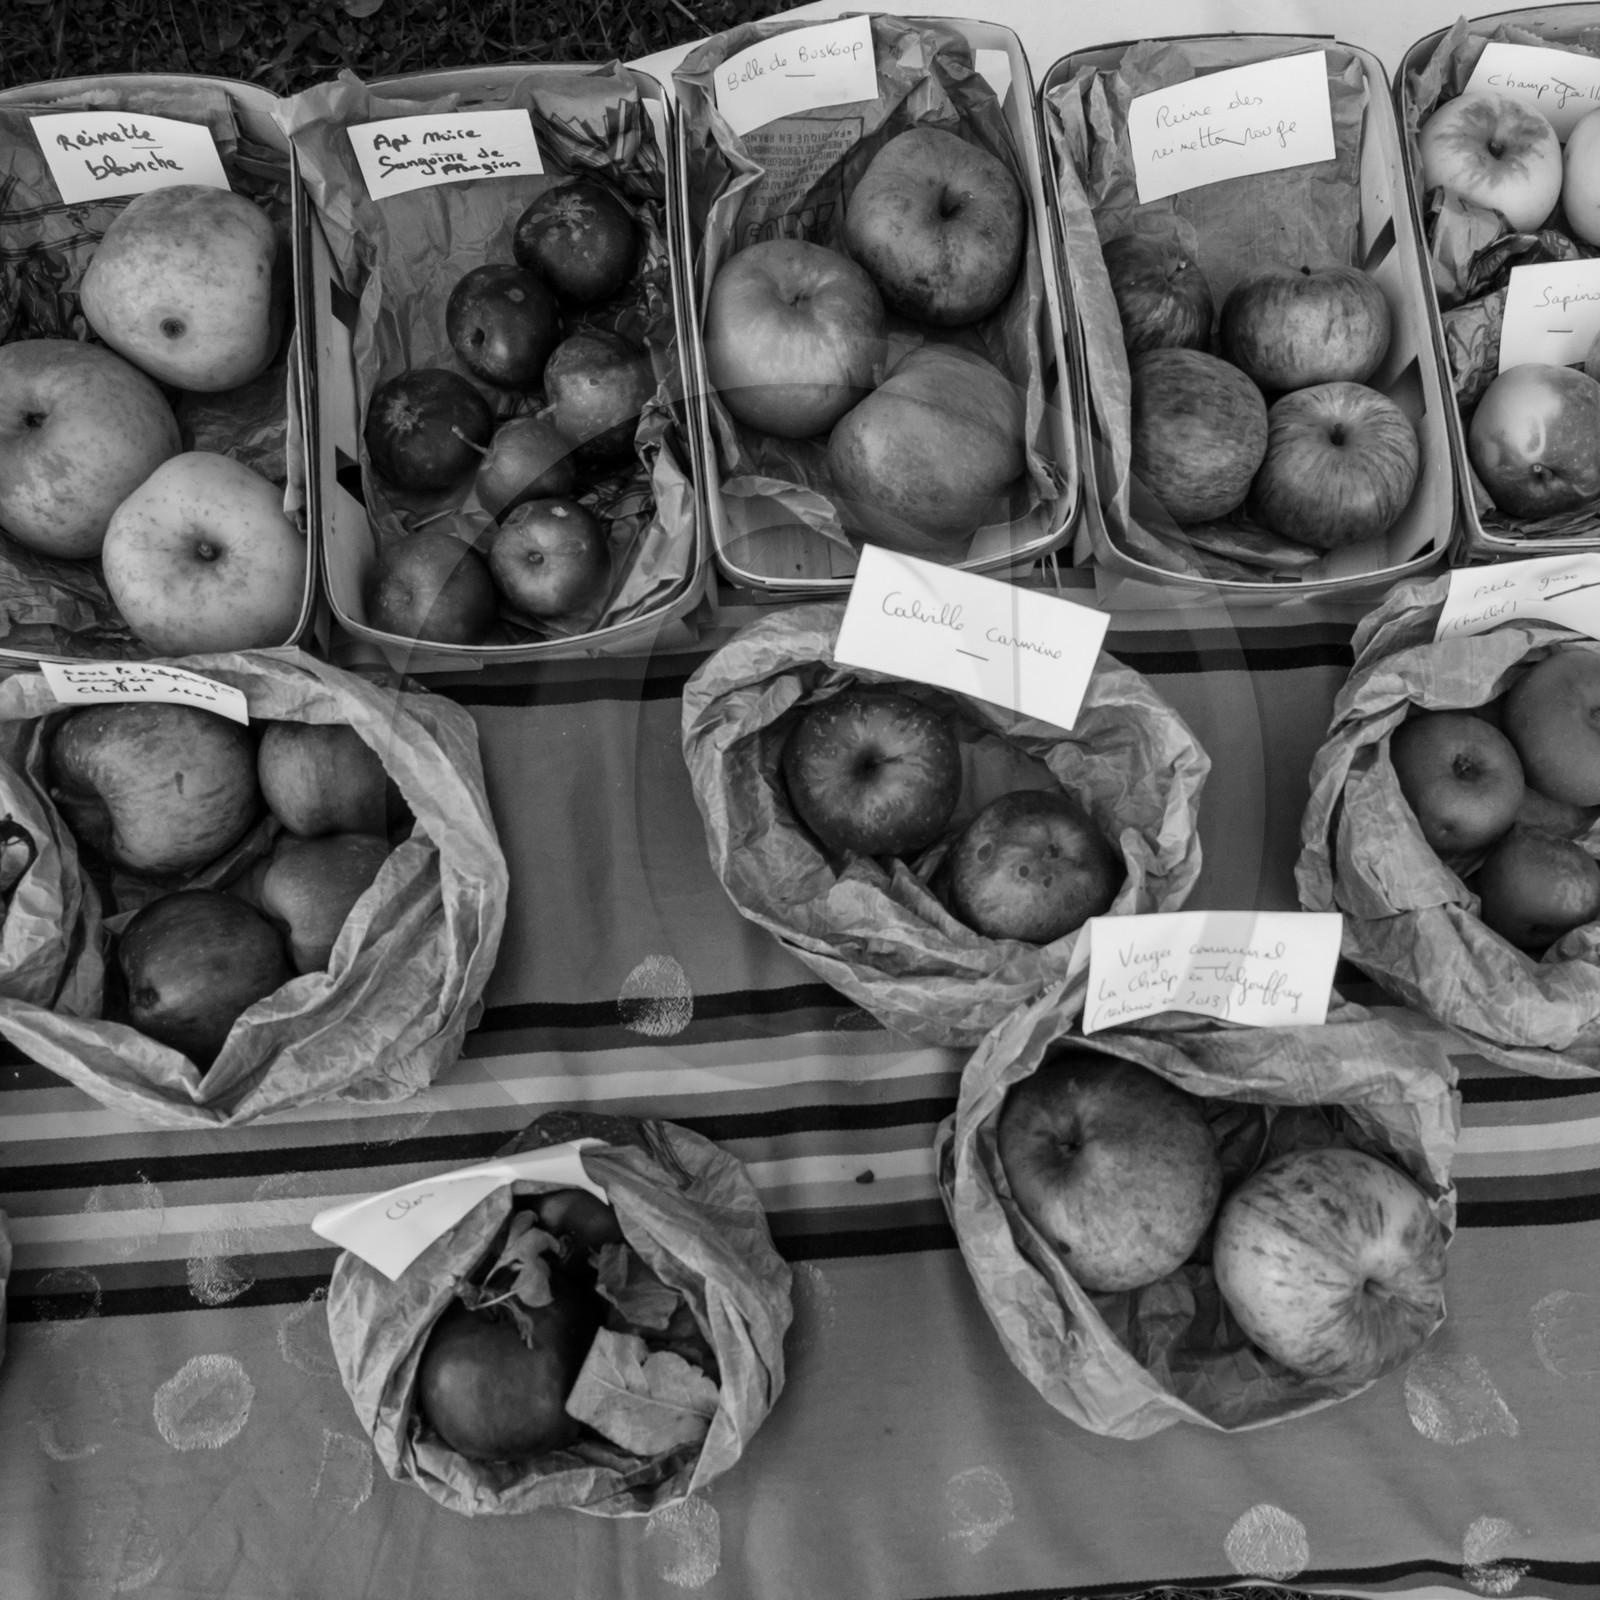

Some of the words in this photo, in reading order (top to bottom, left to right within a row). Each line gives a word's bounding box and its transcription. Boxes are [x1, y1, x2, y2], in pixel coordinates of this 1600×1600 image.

[727, 58, 765, 92] Belle
[769, 53, 787, 71] de
[1487, 72, 1550, 100] Champ
[1156, 103, 1212, 129] Reine
[1227, 90, 1263, 110] des
[1243, 120, 1297, 149] rouge
[84, 151, 184, 181] blanche
[477, 147, 504, 159] de
[881, 591, 965, 632] Calville
[985, 627, 1063, 660] Carmine
[1098, 979, 1118, 1001] La
[1188, 972, 1204, 983] en
